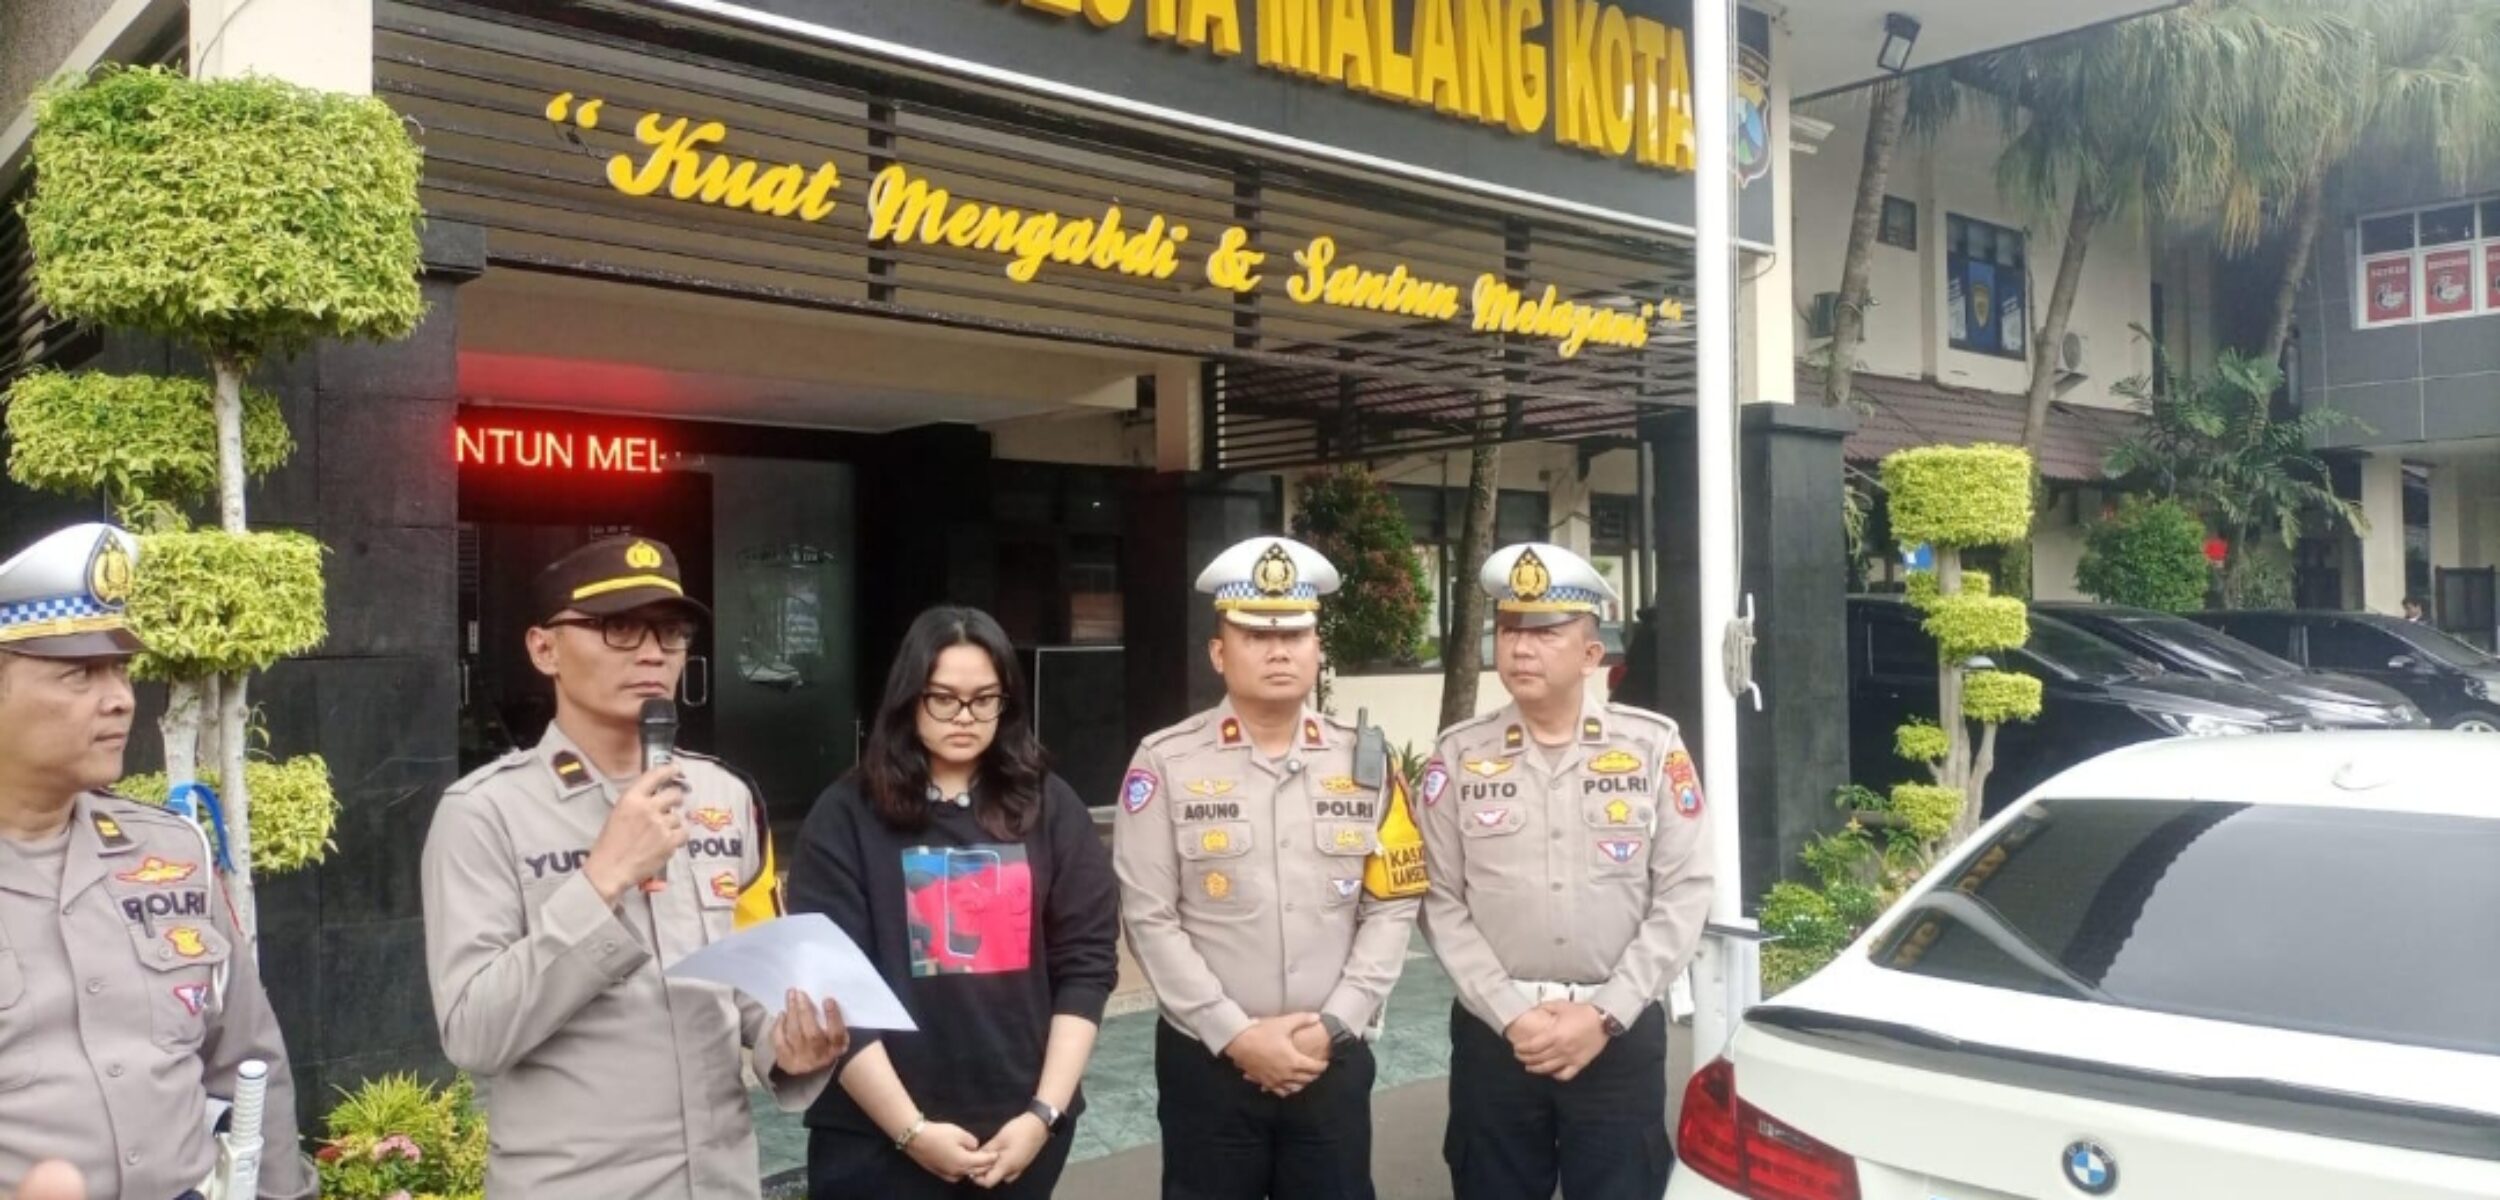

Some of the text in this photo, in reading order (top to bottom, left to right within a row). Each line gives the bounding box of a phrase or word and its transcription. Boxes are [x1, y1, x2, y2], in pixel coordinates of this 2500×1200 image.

[1553, 0, 1695, 172] KOTA
[868, 165, 1188, 283] Mengabdi
[1206, 227, 1265, 292] &
[1286, 236, 1459, 320] Santun
[1460, 782, 1517, 801] FUTO
[1583, 776, 1648, 794] POLRI
[1184, 803, 1239, 820] AGUNG
[1315, 801, 1374, 818] POLRI
[122, 891, 208, 924] POLRI
